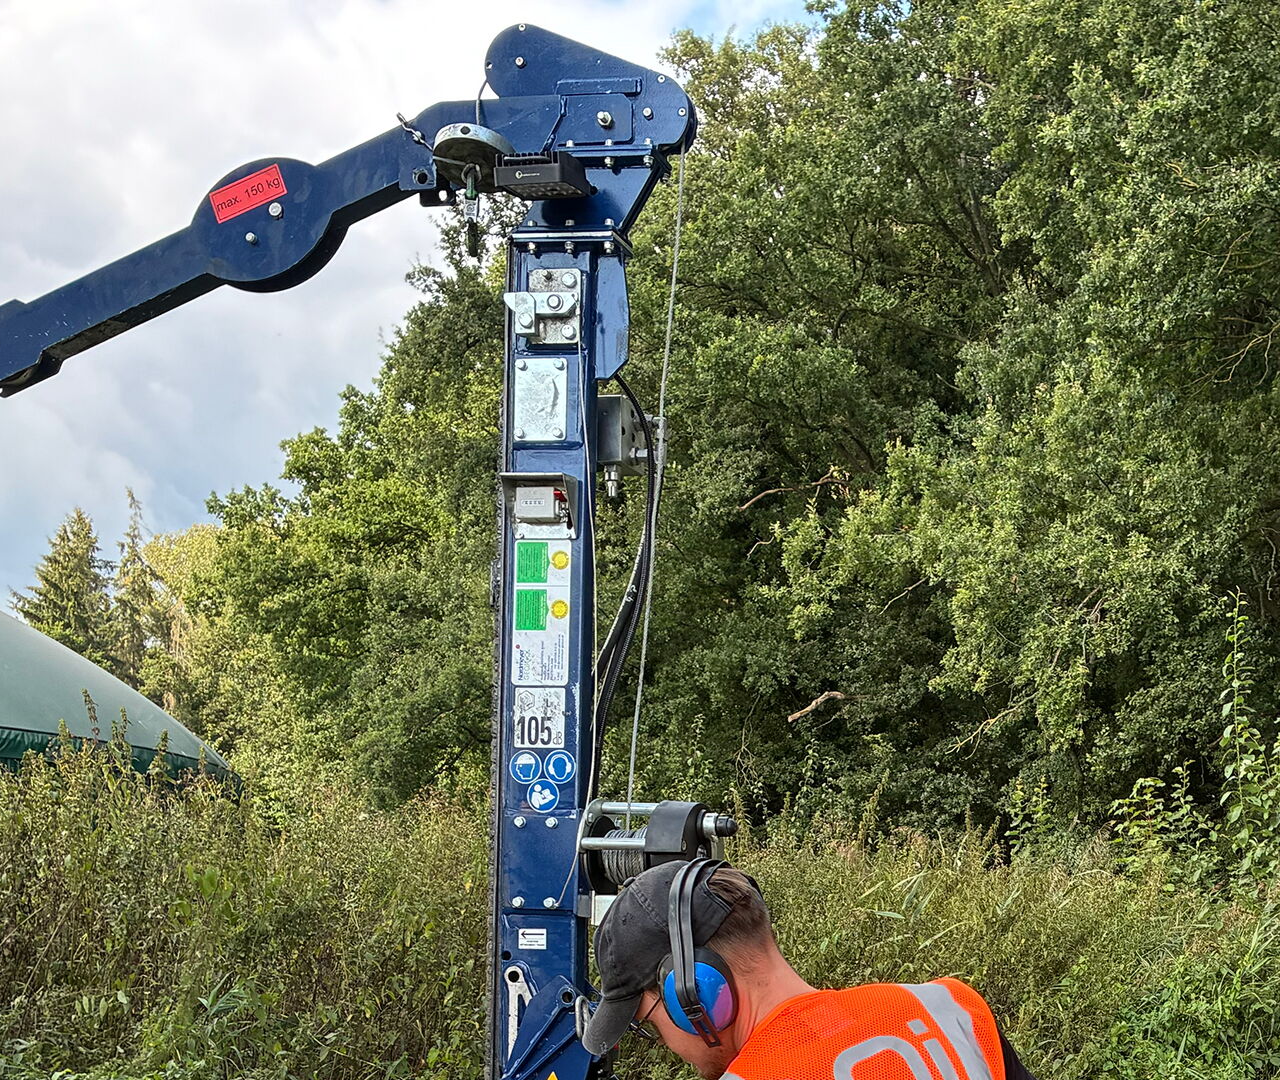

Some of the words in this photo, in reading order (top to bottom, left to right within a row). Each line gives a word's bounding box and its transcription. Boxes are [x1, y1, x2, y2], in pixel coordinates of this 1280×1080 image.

[216, 195, 242, 212] max.
[245, 182, 265, 199] 150
[266, 177, 280, 190] kg
[517, 716, 552, 745] 105
[553, 731, 563, 745] dB
